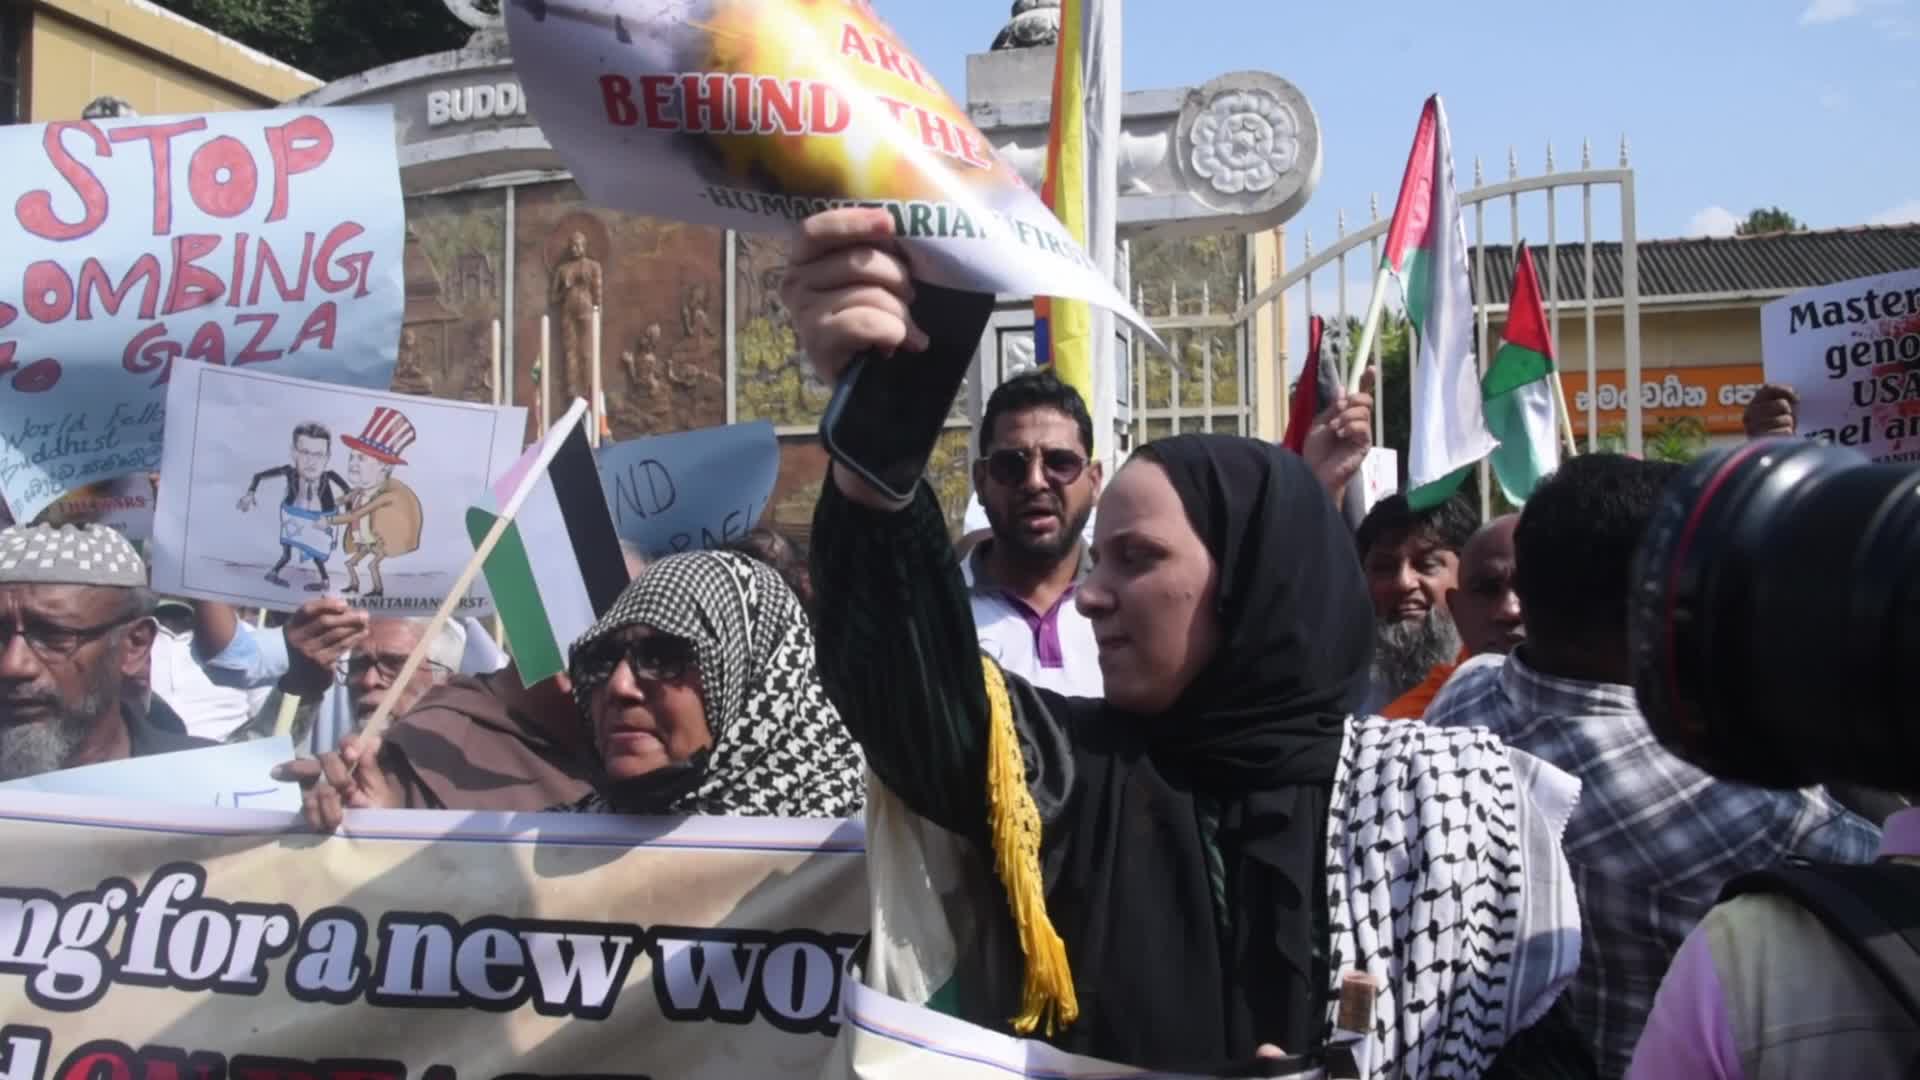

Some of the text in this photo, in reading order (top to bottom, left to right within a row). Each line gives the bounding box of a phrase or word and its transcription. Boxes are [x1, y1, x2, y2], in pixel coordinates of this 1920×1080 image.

[599, 72, 851, 135] BEHIND
[15, 115, 334, 242] STOP
[0, 221, 374, 328] OMBING
[122, 301, 337, 389] GAZA
[1825, 335, 1920, 379] geno
[120, 872, 290, 984] for
[295, 917, 361, 993] a
[376, 921, 633, 1007] new
